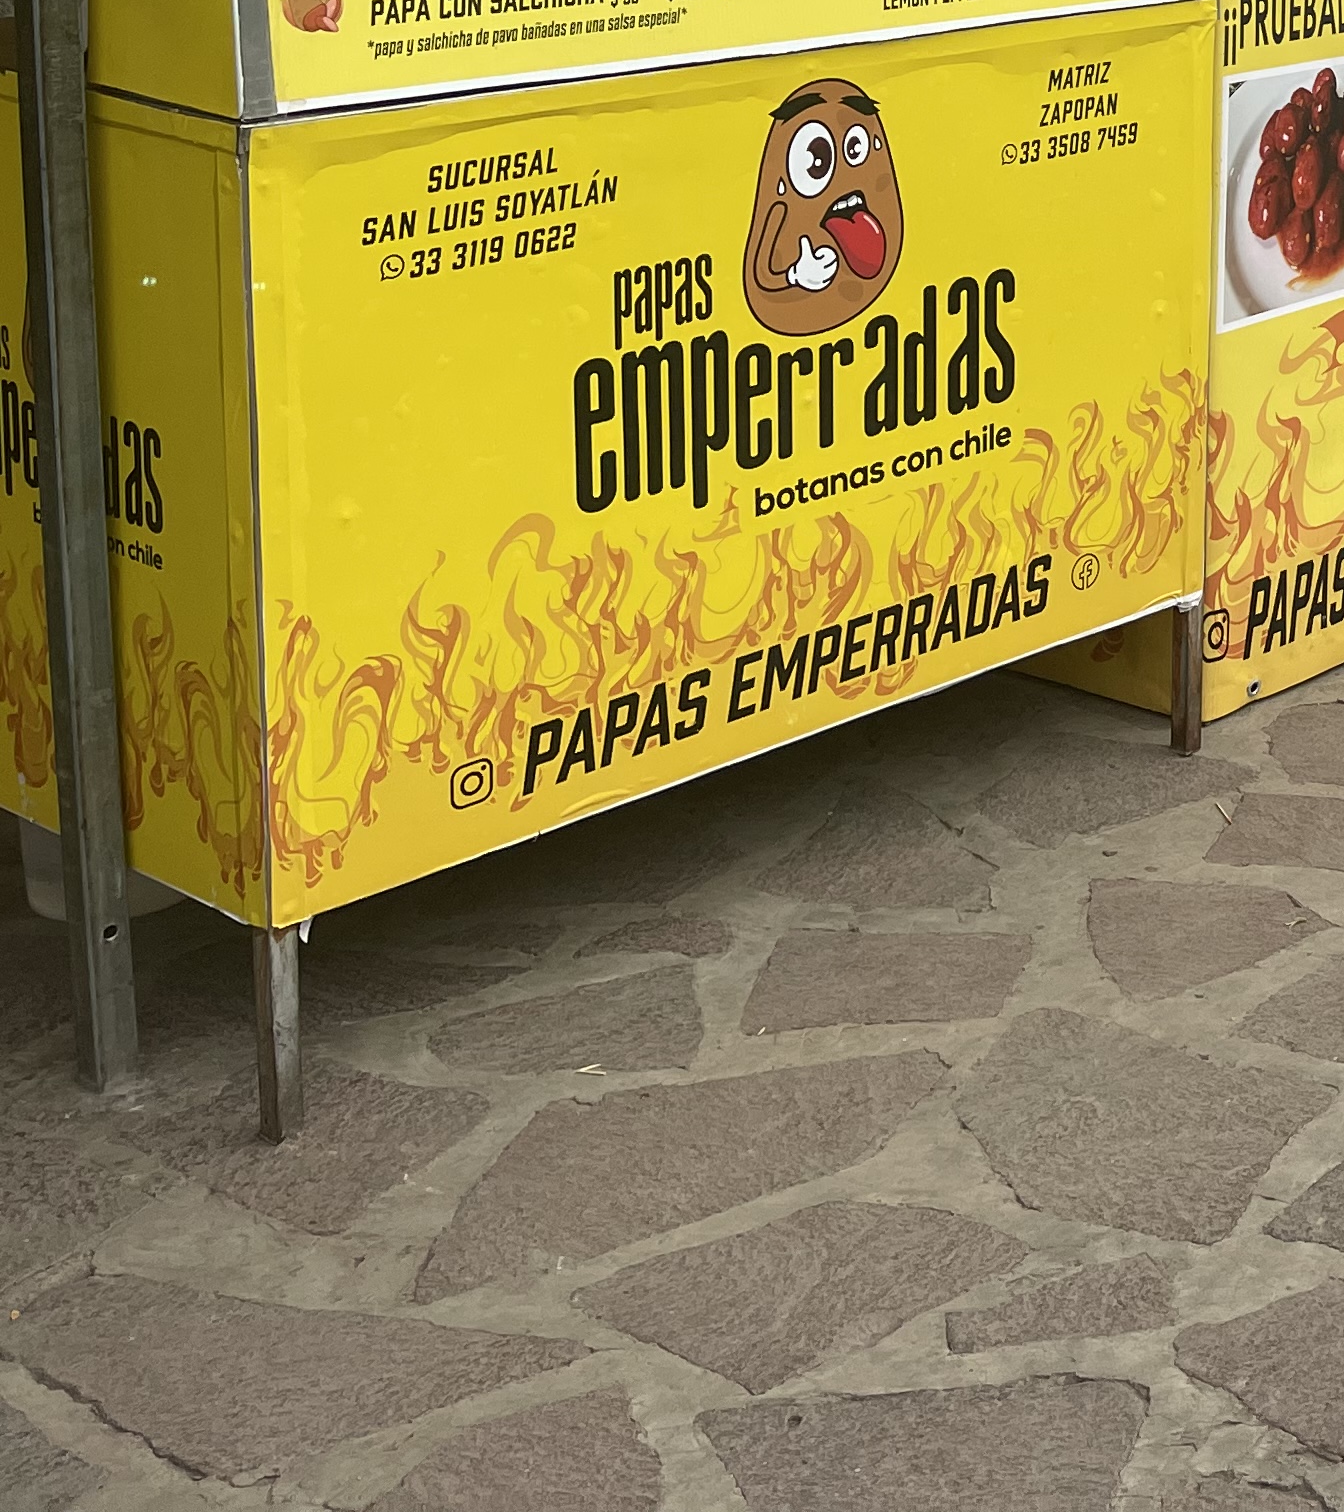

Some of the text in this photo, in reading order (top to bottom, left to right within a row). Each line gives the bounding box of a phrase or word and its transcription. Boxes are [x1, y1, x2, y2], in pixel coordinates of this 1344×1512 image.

[407, 39, 414, 56] y
[417, 30, 472, 52] salchicha
[476, 28, 489, 45] de
[492, 28, 518, 47] pavo
[521, 21, 567, 40] bañadas
[570, 22, 582, 35] en
[586, 19, 605, 33] una
[608, 13, 635, 31] salsa
[1048, 62, 1111, 92] MATRIZ
[1040, 93, 1118, 127] ZAPOPAN
[1020, 122, 1138, 164] 33 3508 7459
[428, 147, 557, 193] SUCURSAL
[362, 169, 617, 245] SAN LUIS SOYATLÁN
[410, 223, 576, 278] 33 3119 0622
[614, 254, 712, 350] papas
[574, 268, 1015, 514] emperradas
[755, 423, 1011, 517] botanas con chile
[128, 540, 163, 570] chile
[523, 554, 1052, 796] PAPAS EMPERRADAS
